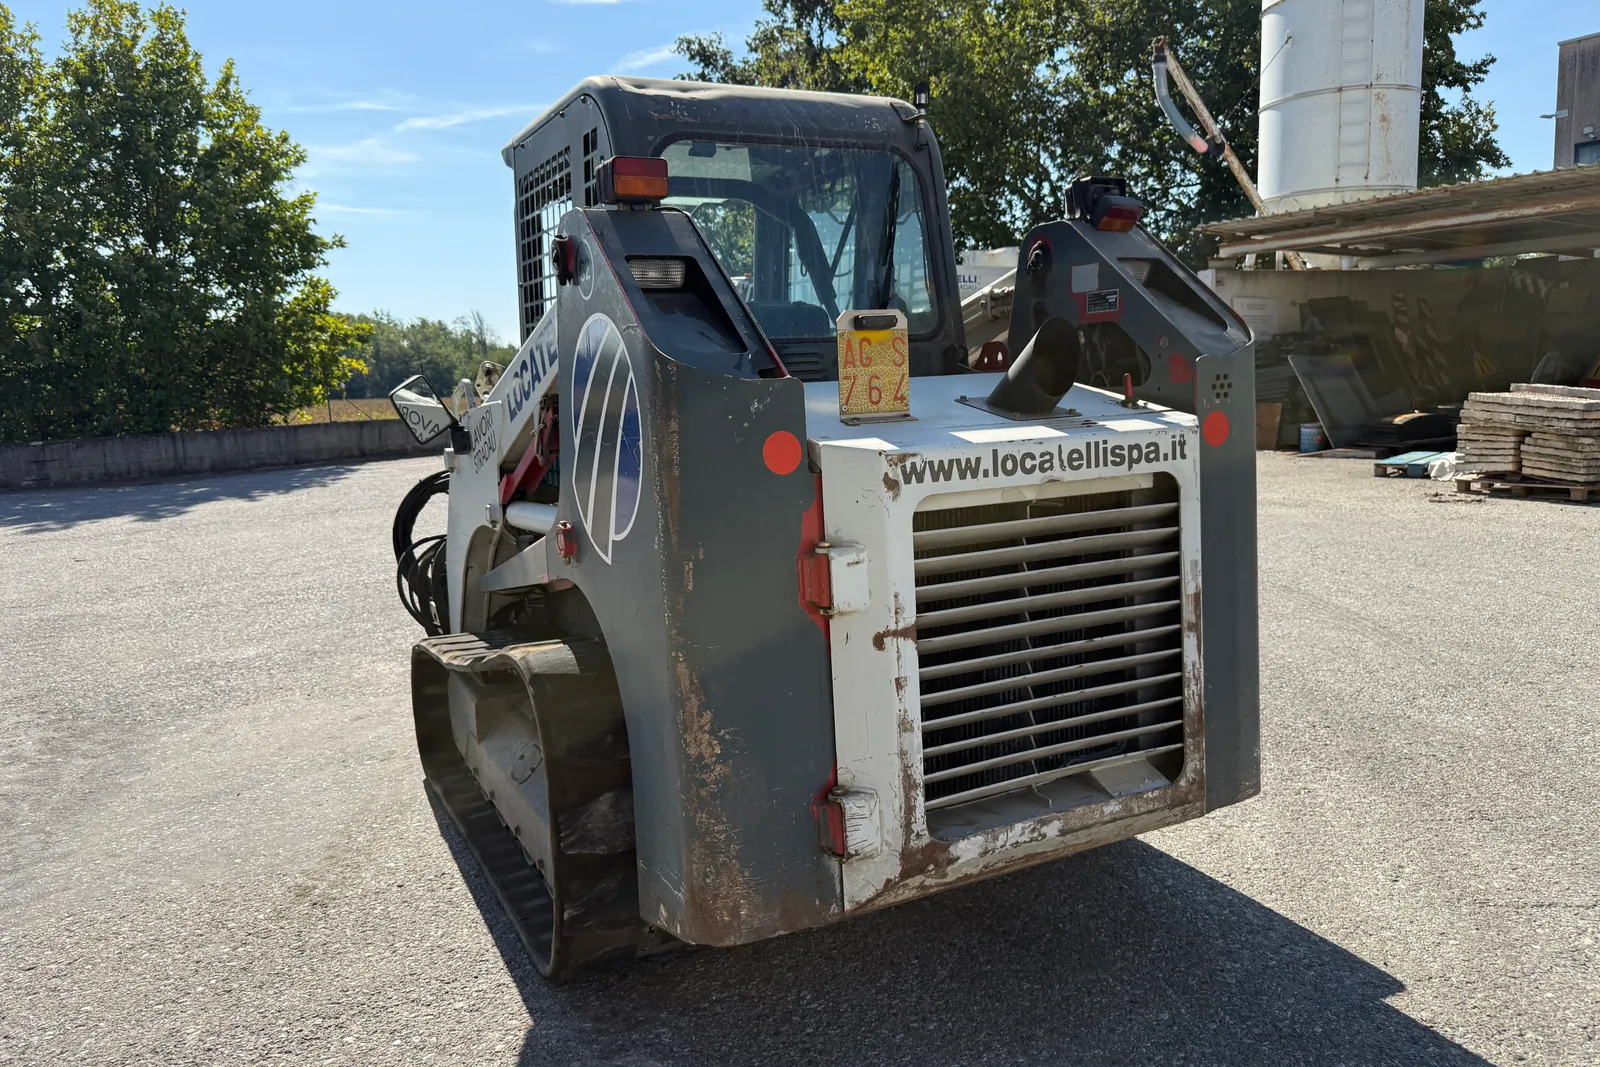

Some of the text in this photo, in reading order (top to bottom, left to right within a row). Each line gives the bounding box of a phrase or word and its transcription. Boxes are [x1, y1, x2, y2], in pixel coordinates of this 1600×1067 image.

[843, 336, 905, 369] AG S
[471, 406, 494, 451] LAVORI
[901, 434, 1187, 485] www.locatellispa.it
